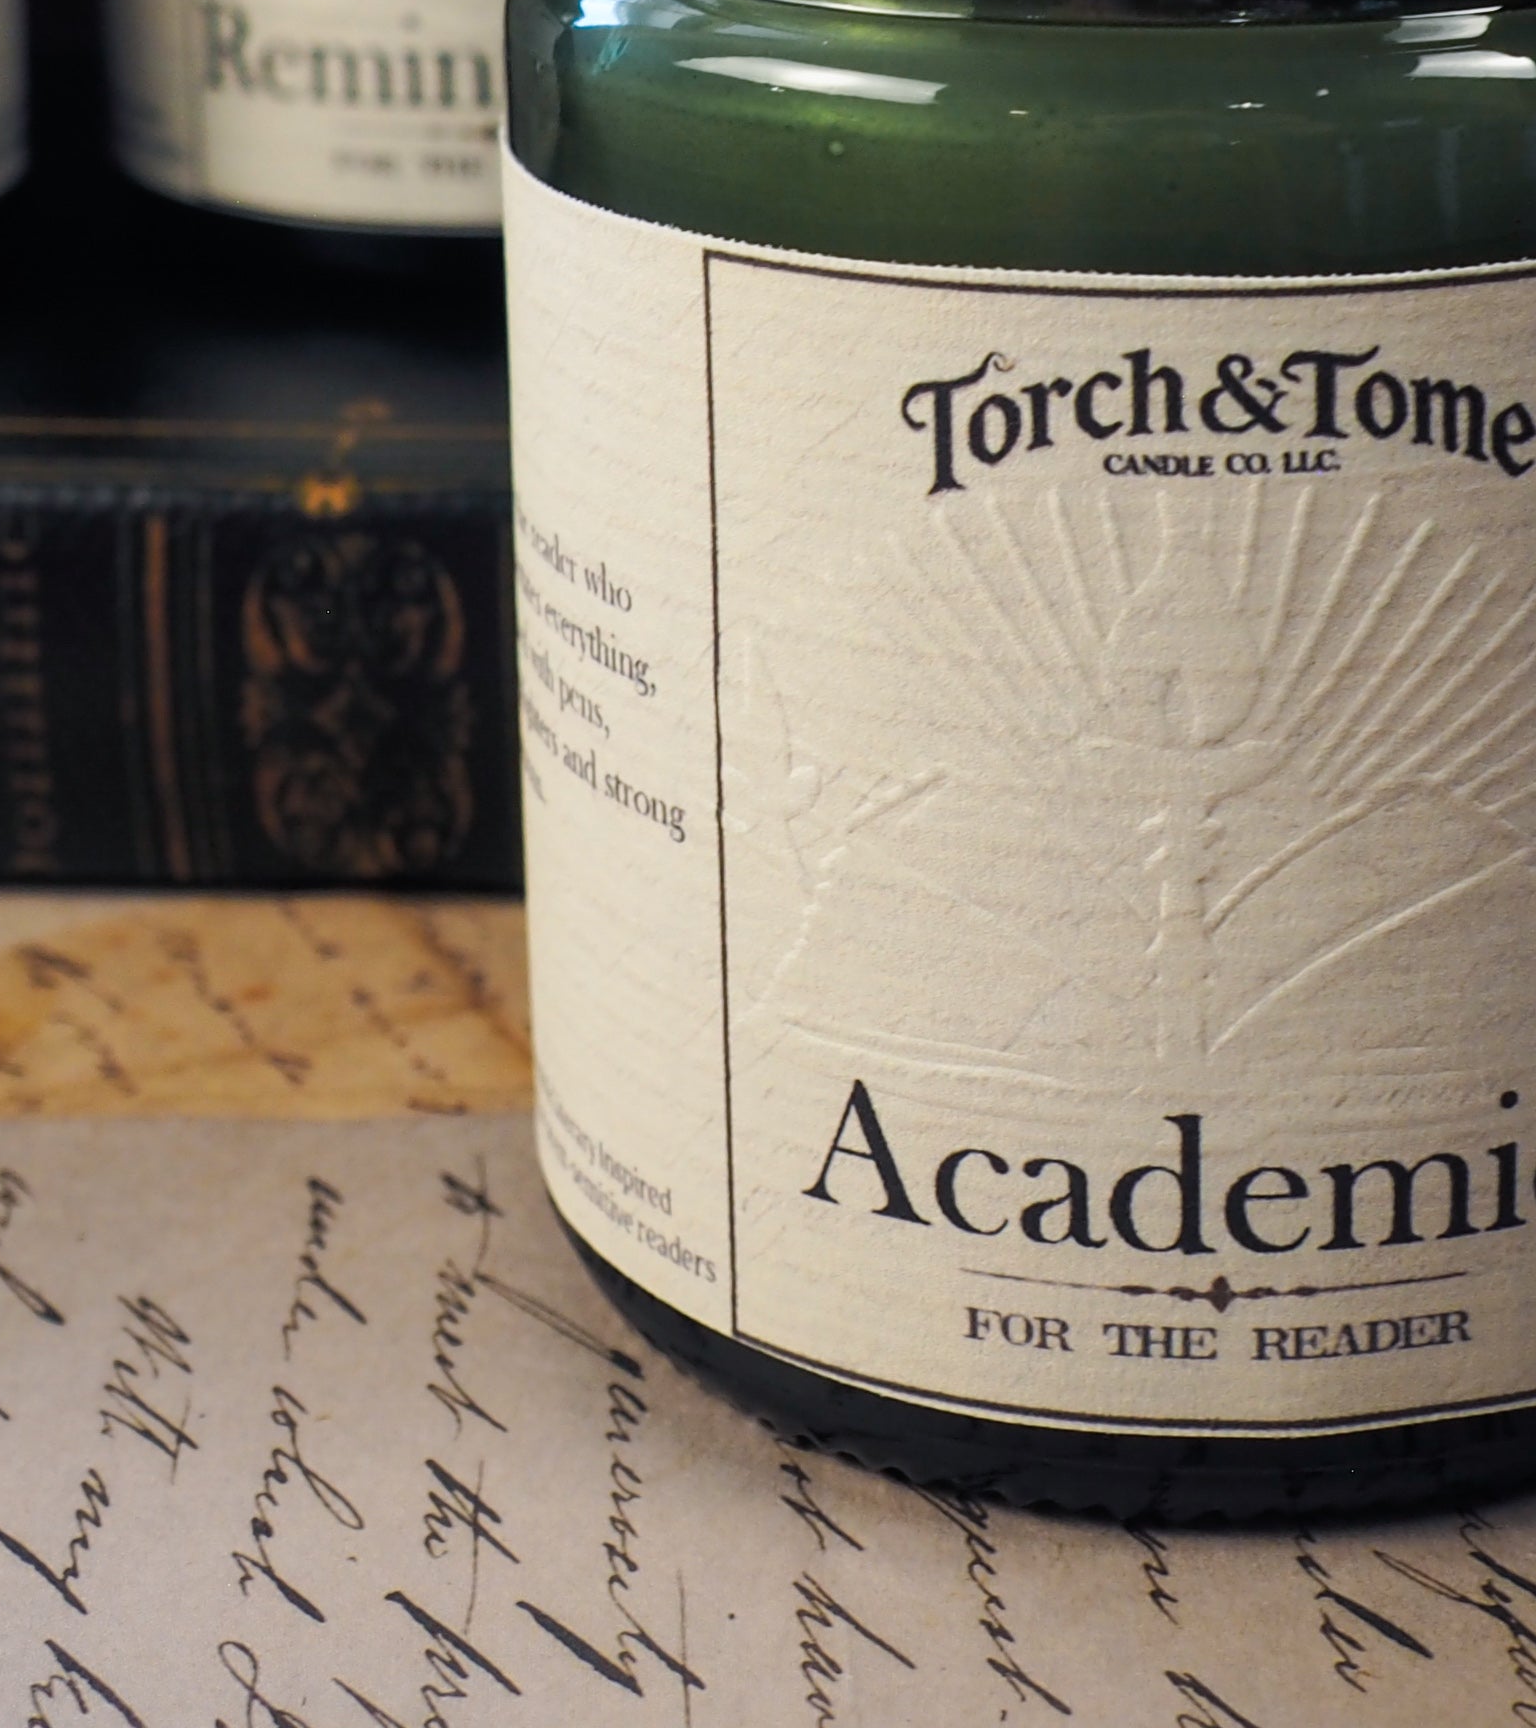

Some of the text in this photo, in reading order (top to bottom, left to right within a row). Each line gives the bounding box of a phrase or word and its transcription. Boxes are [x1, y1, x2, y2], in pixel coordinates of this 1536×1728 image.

[1103, 452, 1215, 477] CANDLE
[1225, 451, 1273, 475] CO.
[583, 561, 633, 613] who
[544, 602, 658, 698] everything,
[558, 675, 611, 740] pens,
[562, 742, 598, 791] and
[604, 770, 687, 845] strong
[598, 1140, 673, 1217] Inspired
[637, 1220, 718, 1285] readers
[963, 1305, 1474, 1362] FOR THE READER
